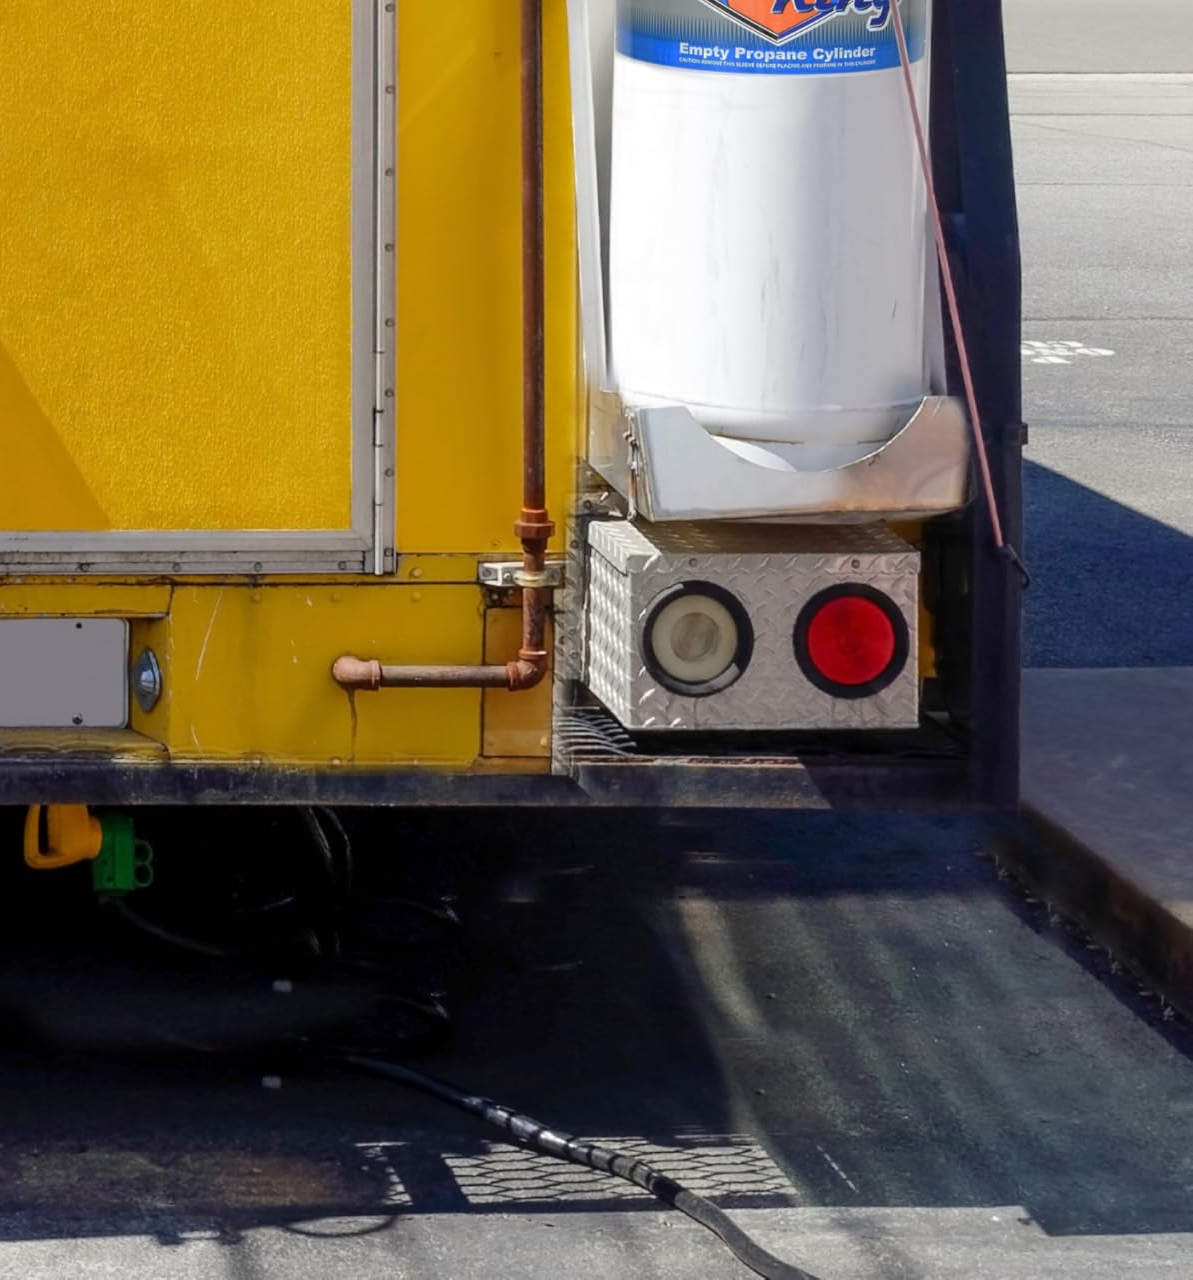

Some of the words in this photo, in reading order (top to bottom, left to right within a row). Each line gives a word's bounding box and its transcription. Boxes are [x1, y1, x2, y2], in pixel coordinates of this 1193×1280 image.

[679, 42, 729, 60] Empty
[735, 46, 807, 62] Propane
[813, 46, 876, 62] Cylinder
